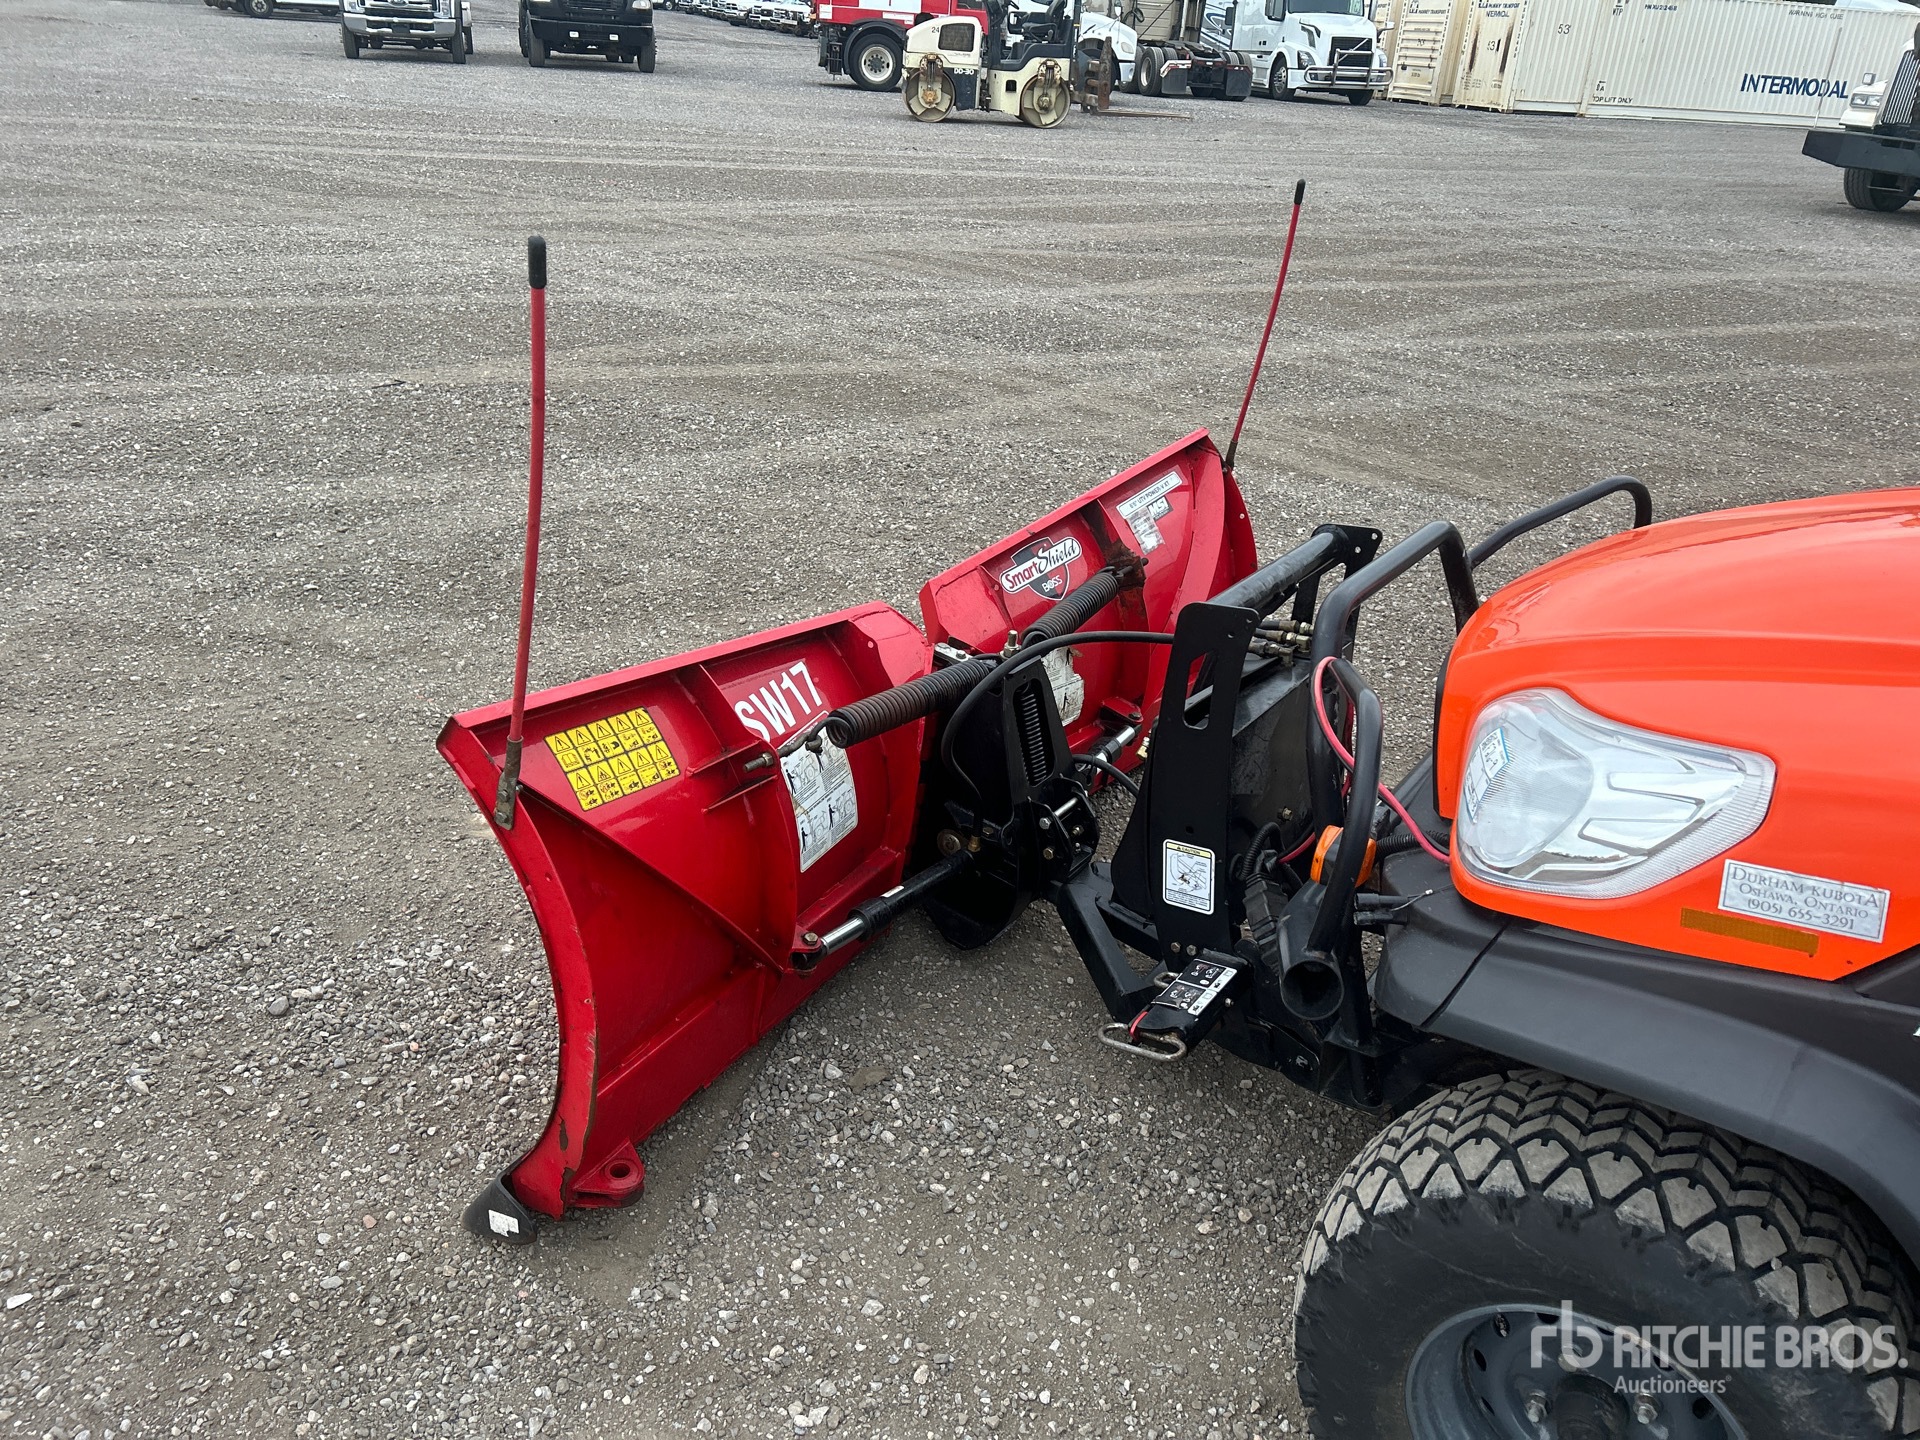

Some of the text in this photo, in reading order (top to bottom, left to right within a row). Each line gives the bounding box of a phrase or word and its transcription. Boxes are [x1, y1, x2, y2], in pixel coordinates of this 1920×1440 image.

[1740, 72, 1849, 99] INTERMODAL
[1041, 575, 1063, 593] BOSS
[734, 661, 823, 743] SW17
[1731, 866, 1880, 909] DURHAM KUBOTA
[1739, 882, 1869, 919] OSHAWA, ONTARIO
[1747, 897, 1856, 931] (905) 655-3291
